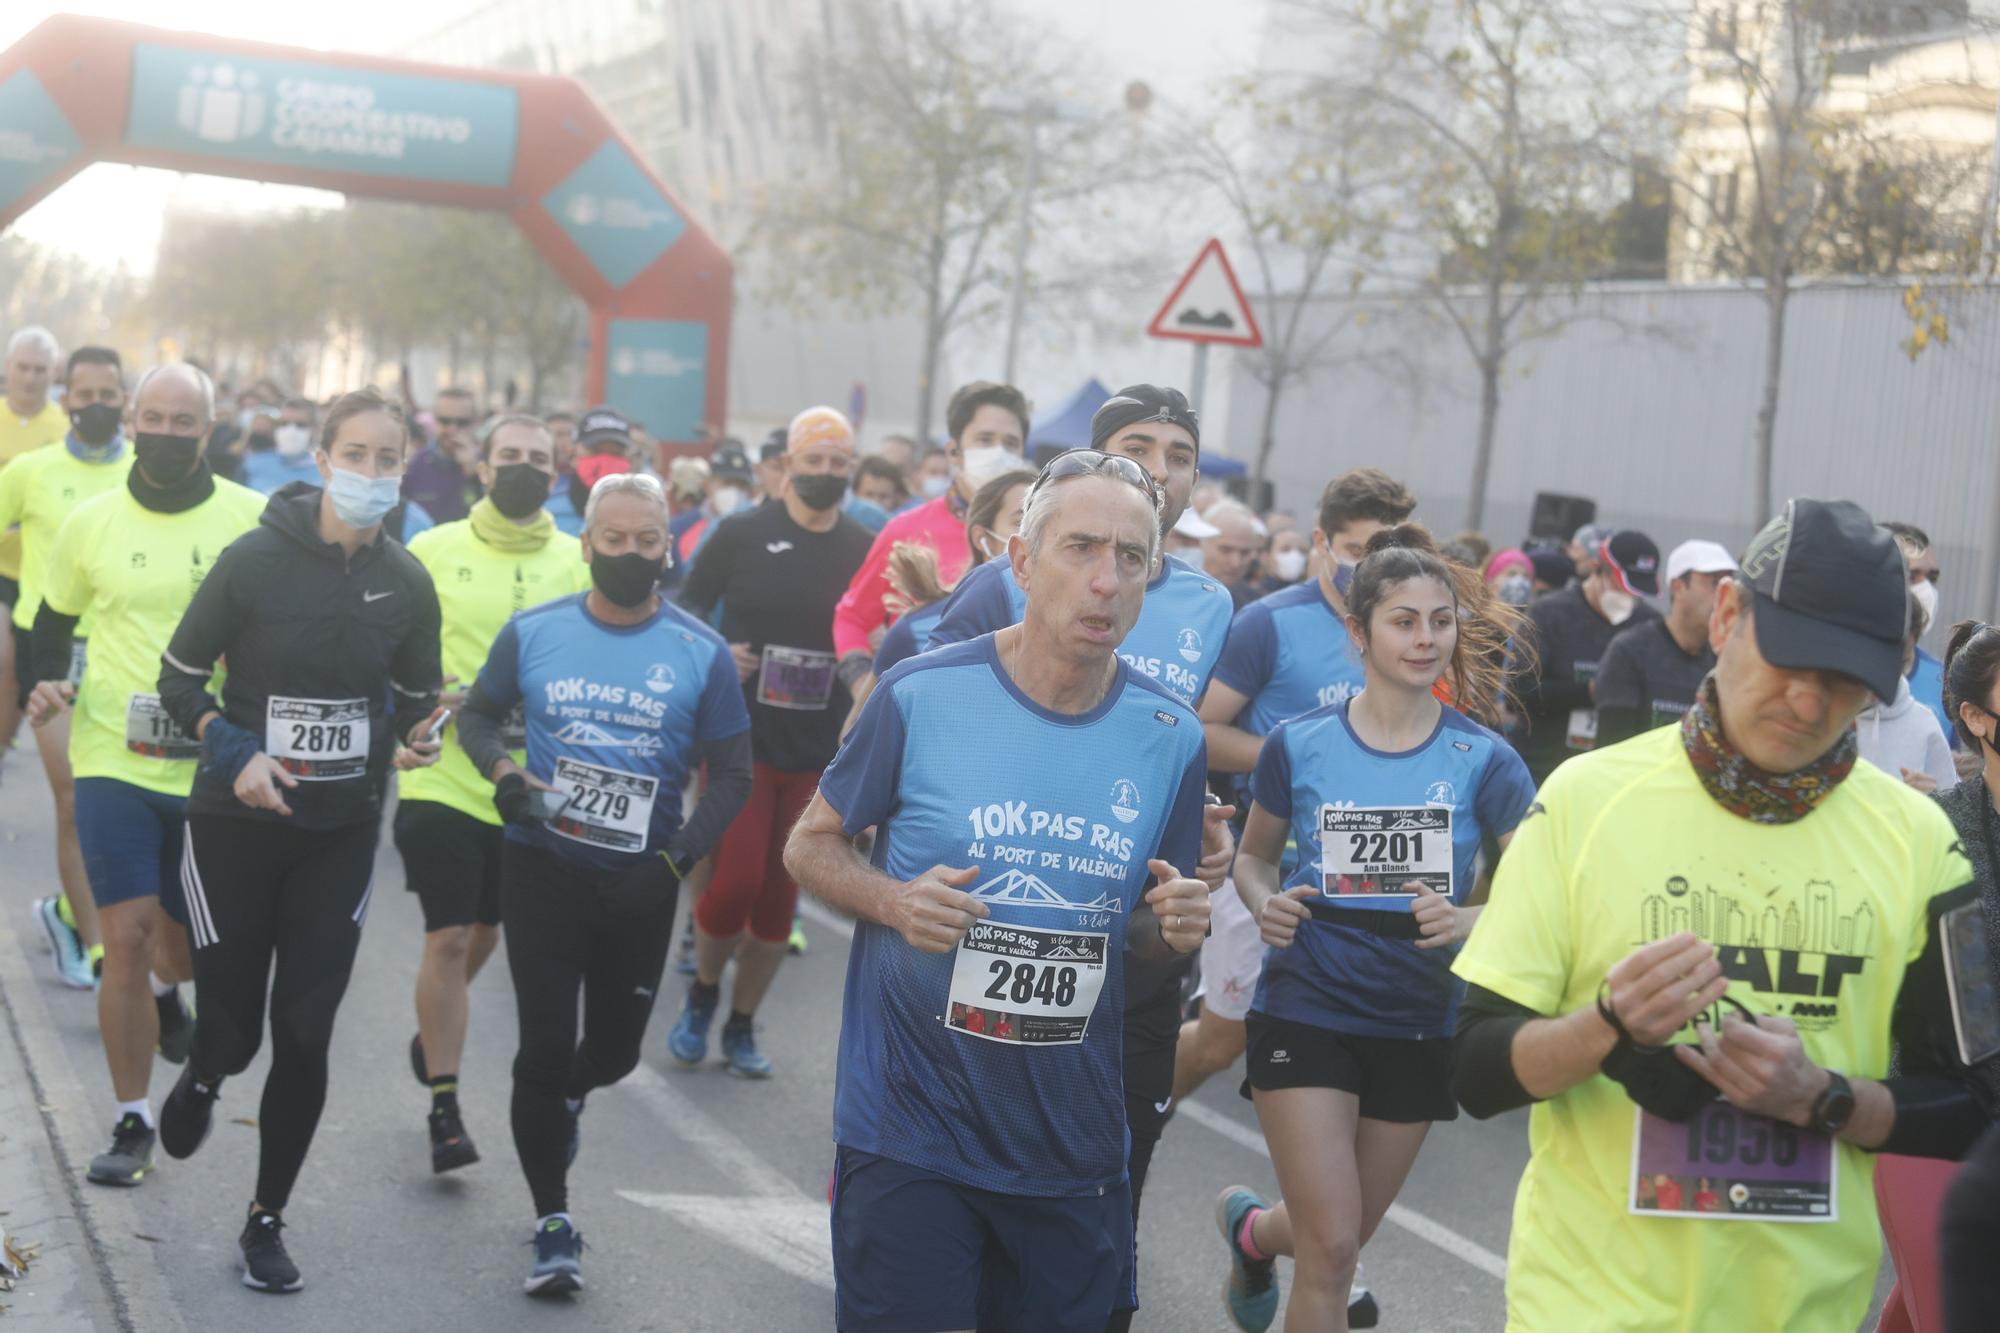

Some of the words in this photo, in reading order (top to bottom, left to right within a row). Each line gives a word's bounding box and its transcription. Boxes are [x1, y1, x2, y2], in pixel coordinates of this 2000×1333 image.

[274, 100, 471, 144] COOPERATIVO
[1166, 663, 1199, 694] RAS
[1316, 681, 1350, 706] 10K
[544, 677, 586, 704] 10K
[586, 683, 627, 704] PAS
[628, 691, 668, 718] RAS
[560, 706, 592, 719] PORT
[595, 710, 611, 722] DE
[291, 724, 352, 752] 2878
[570, 784, 630, 821] 2279
[1326, 811, 1345, 825] 10K
[1345, 813, 1363, 822] PAS
[1365, 814, 1383, 825] RAS
[968, 800, 1028, 840] 10K
[1030, 811, 1086, 841] PAS
[1090, 824, 1134, 862] RAS
[967, 842, 986, 859] AL
[993, 845, 1035, 866] PORT
[1041, 852, 1062, 869] DE
[1068, 854, 1128, 881] VALÈNCIA
[1350, 832, 1423, 864] 2201
[1364, 864, 1379, 873] Ana
[1382, 864, 1410, 873] Blanes
[968, 926, 993, 940] 10K
[993, 930, 1016, 942] PAS
[1018, 934, 1040, 950] RAS
[977, 942, 996, 952] PORT
[998, 945, 1007, 953] DE
[984, 959, 1077, 1008] 2848
[1713, 945, 1865, 998] ALT
